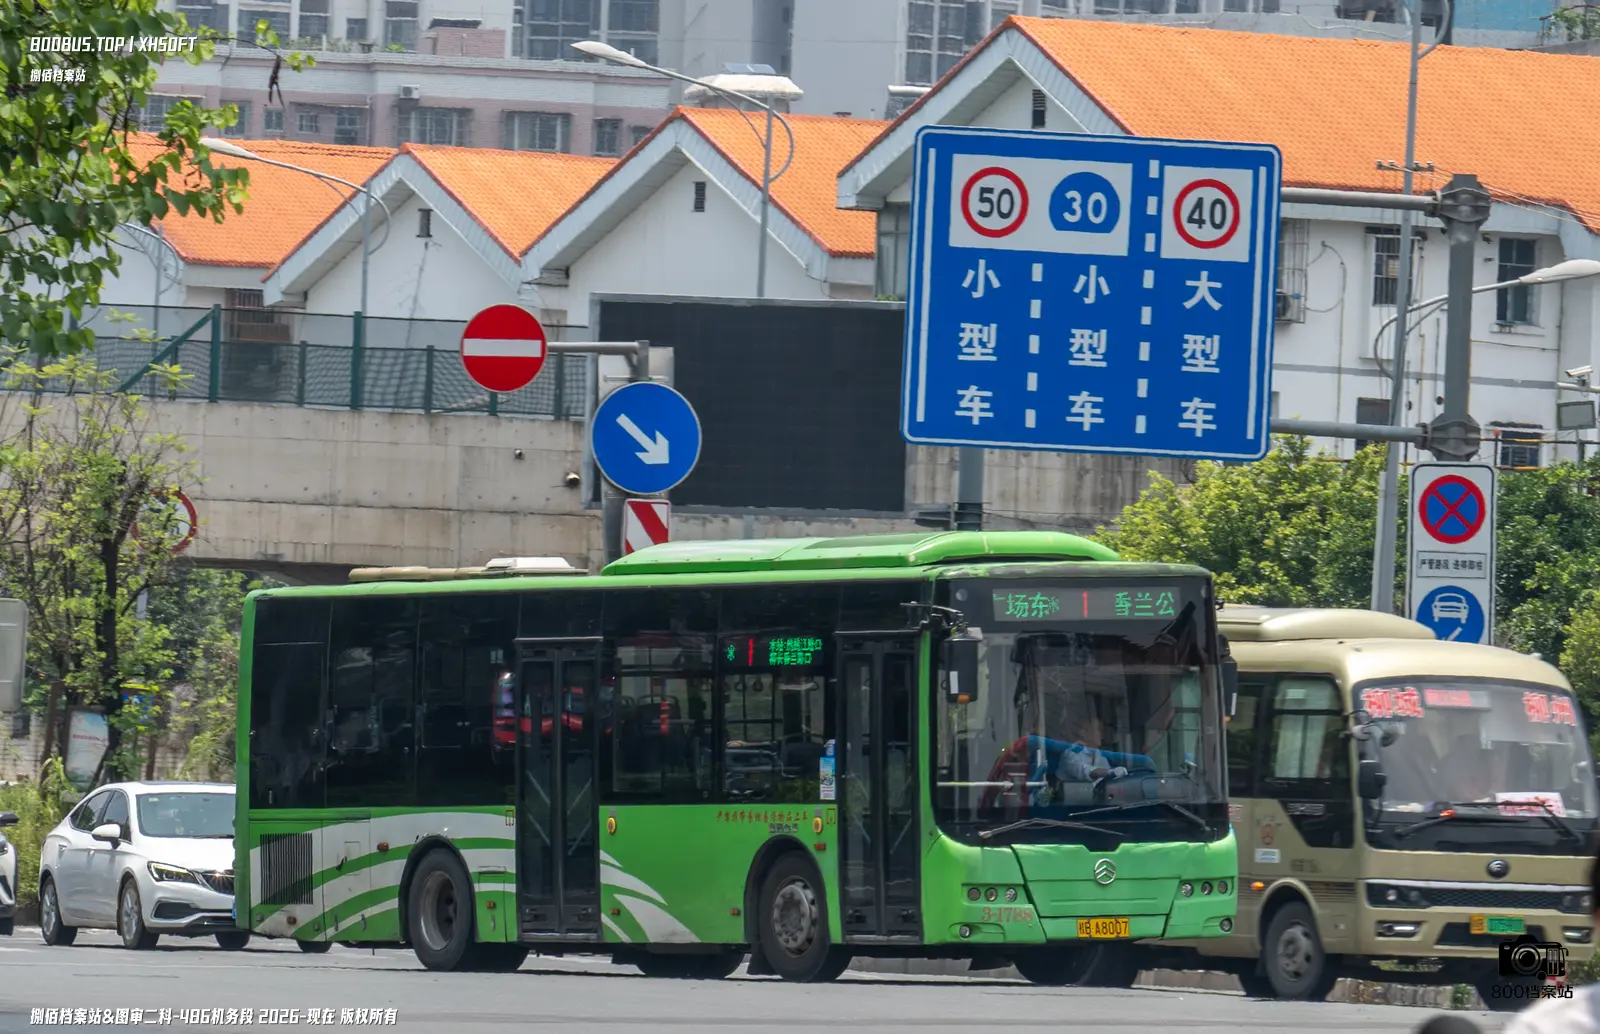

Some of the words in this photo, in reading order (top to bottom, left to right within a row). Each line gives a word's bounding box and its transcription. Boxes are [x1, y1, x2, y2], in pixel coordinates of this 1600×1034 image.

[977, 187, 1015, 219] 50
[1062, 190, 1108, 224] 30
[1187, 197, 1228, 230] 40
[954, 258, 1001, 426] 小型车
[1065, 264, 1111, 432] 小型车
[1177, 270, 1223, 438] 大型车
